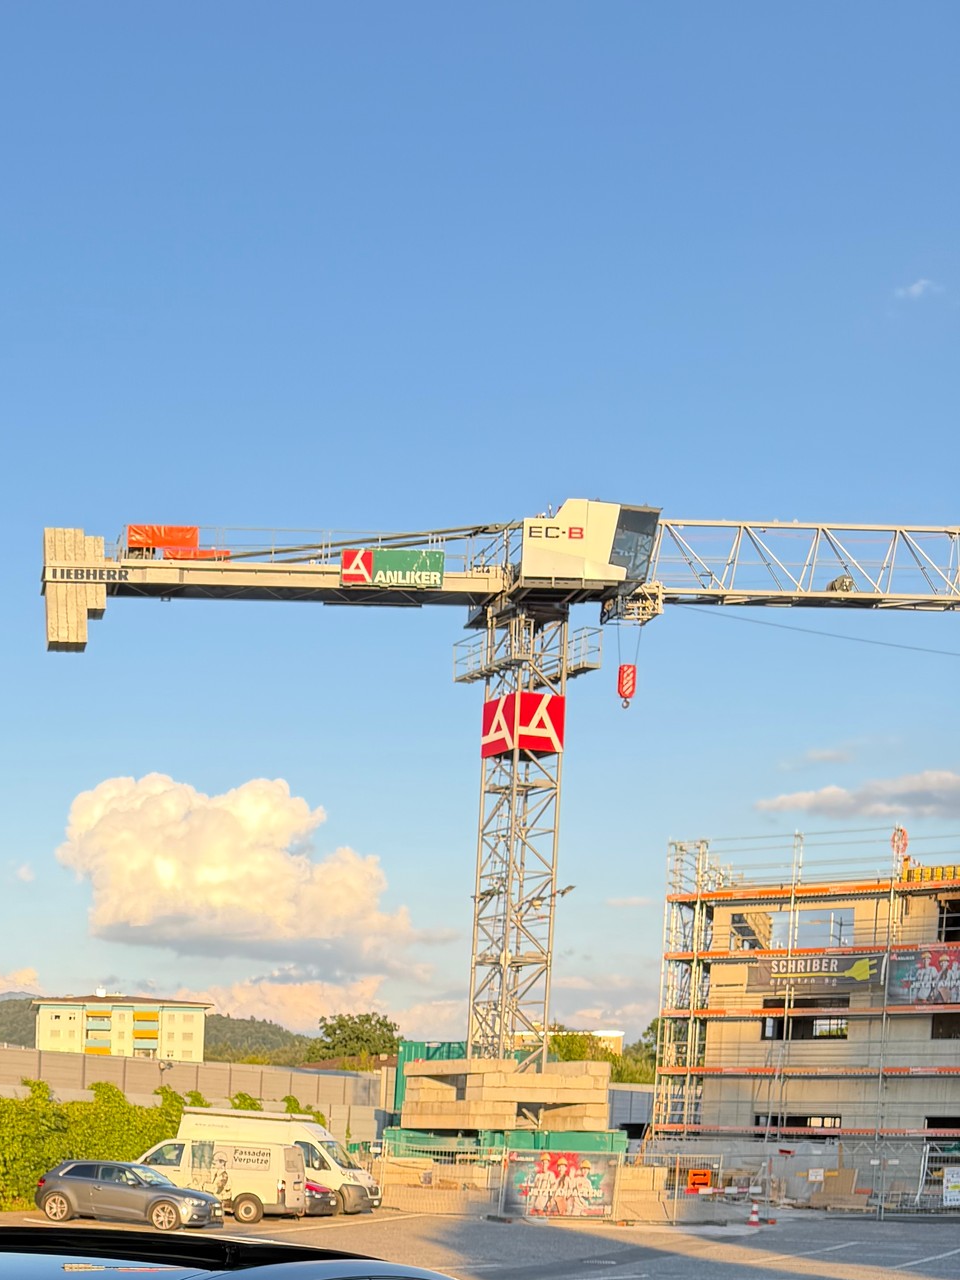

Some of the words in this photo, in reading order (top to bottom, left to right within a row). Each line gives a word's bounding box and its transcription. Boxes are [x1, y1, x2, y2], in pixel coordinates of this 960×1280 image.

[529, 526, 584, 539] EC-B
[373, 570, 441, 585] ANLIKER
[771, 959, 838, 973] SCHRIBER
[234, 1149, 271, 1158] Fassaden
[233, 1156, 269, 1165] Verputze
